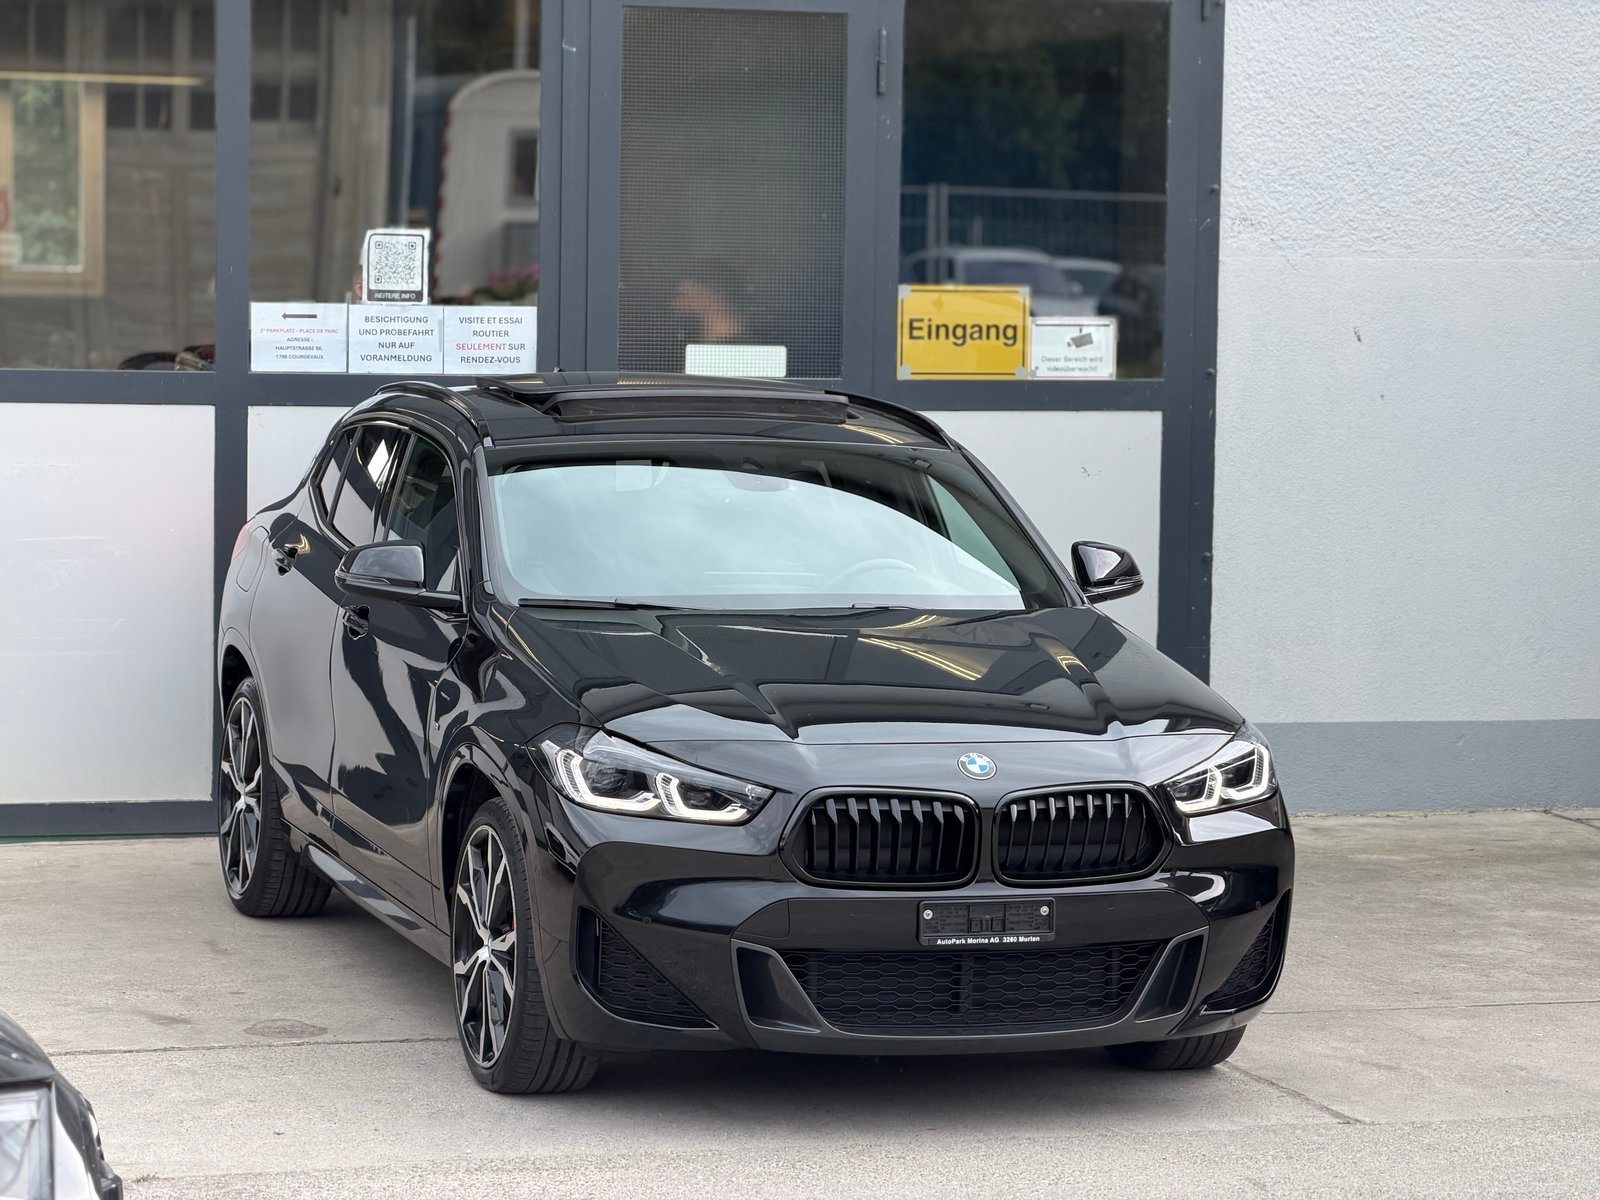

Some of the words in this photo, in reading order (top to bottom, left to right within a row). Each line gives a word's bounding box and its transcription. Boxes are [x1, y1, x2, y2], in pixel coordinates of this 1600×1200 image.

[400, 292, 416, 300] INFO
[364, 315, 429, 324] BESICHTIGUNG
[458, 316, 485, 325] VISITE
[487, 316, 497, 325] ET
[498, 316, 523, 325] ESSAI
[379, 329, 435, 337] PROBEFAHRT
[472, 330, 510, 338] ROUTIER
[908, 318, 1018, 347] Eingang
[378, 341, 397, 349] NUR
[398, 341, 415, 349] AUF
[455, 343, 507, 351] SEULEMENT
[507, 343, 526, 351] SUR
[360, 354, 433, 362] VORANMELDUNG
[460, 356, 521, 364] RENDEZ-VOUS
[1018, 935, 1040, 943] Murten
